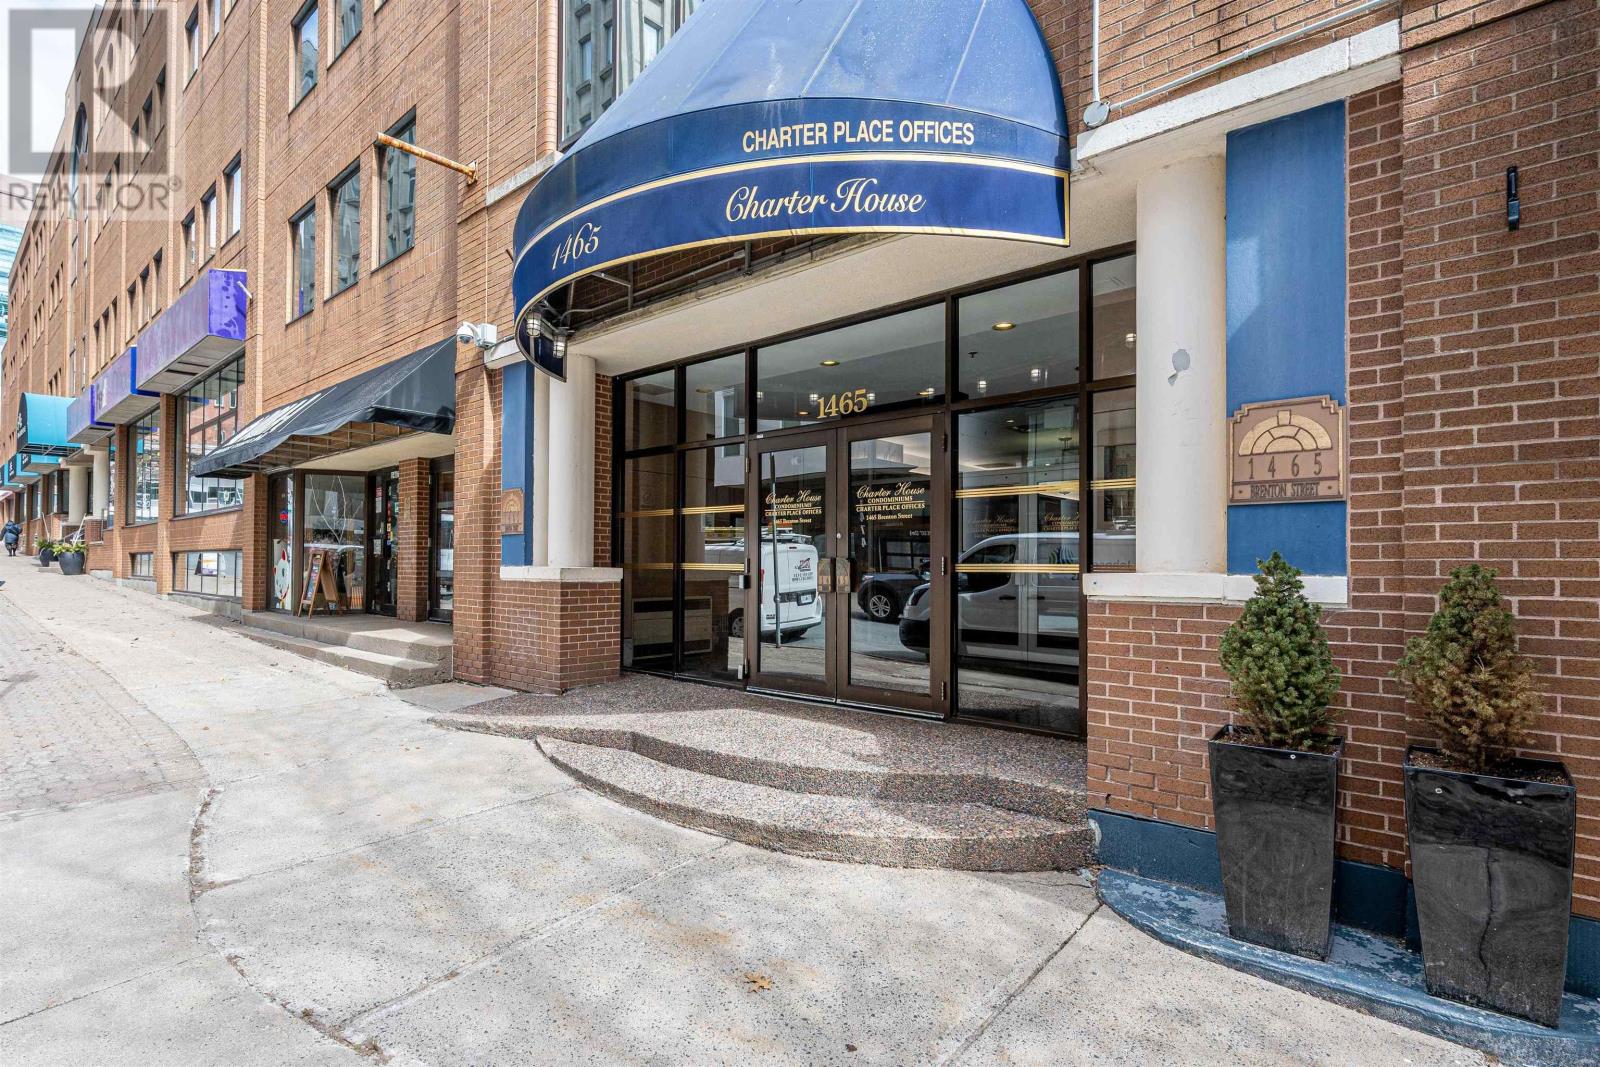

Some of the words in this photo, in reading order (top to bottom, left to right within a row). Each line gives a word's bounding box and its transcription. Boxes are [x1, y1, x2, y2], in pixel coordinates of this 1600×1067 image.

[743, 122, 828, 153] CHARTER
[833, 119, 894, 143] PLACE
[899, 120, 975, 146] OFFICES
[725, 185, 829, 222] Charter
[830, 177, 927, 214] House
[551, 222, 602, 271] 1465
[816, 388, 868, 419] 1465
[765, 492, 794, 504] Charter
[796, 490, 822, 502] House
[856, 485, 891, 499] Charter
[894, 481, 925, 495] House
[1250, 484, 1287, 499] BRENTON
[1291, 481, 1320, 497] STREET
[868, 496, 913, 504] CONDOMINIUMS
[897, 512, 913, 520] Street
